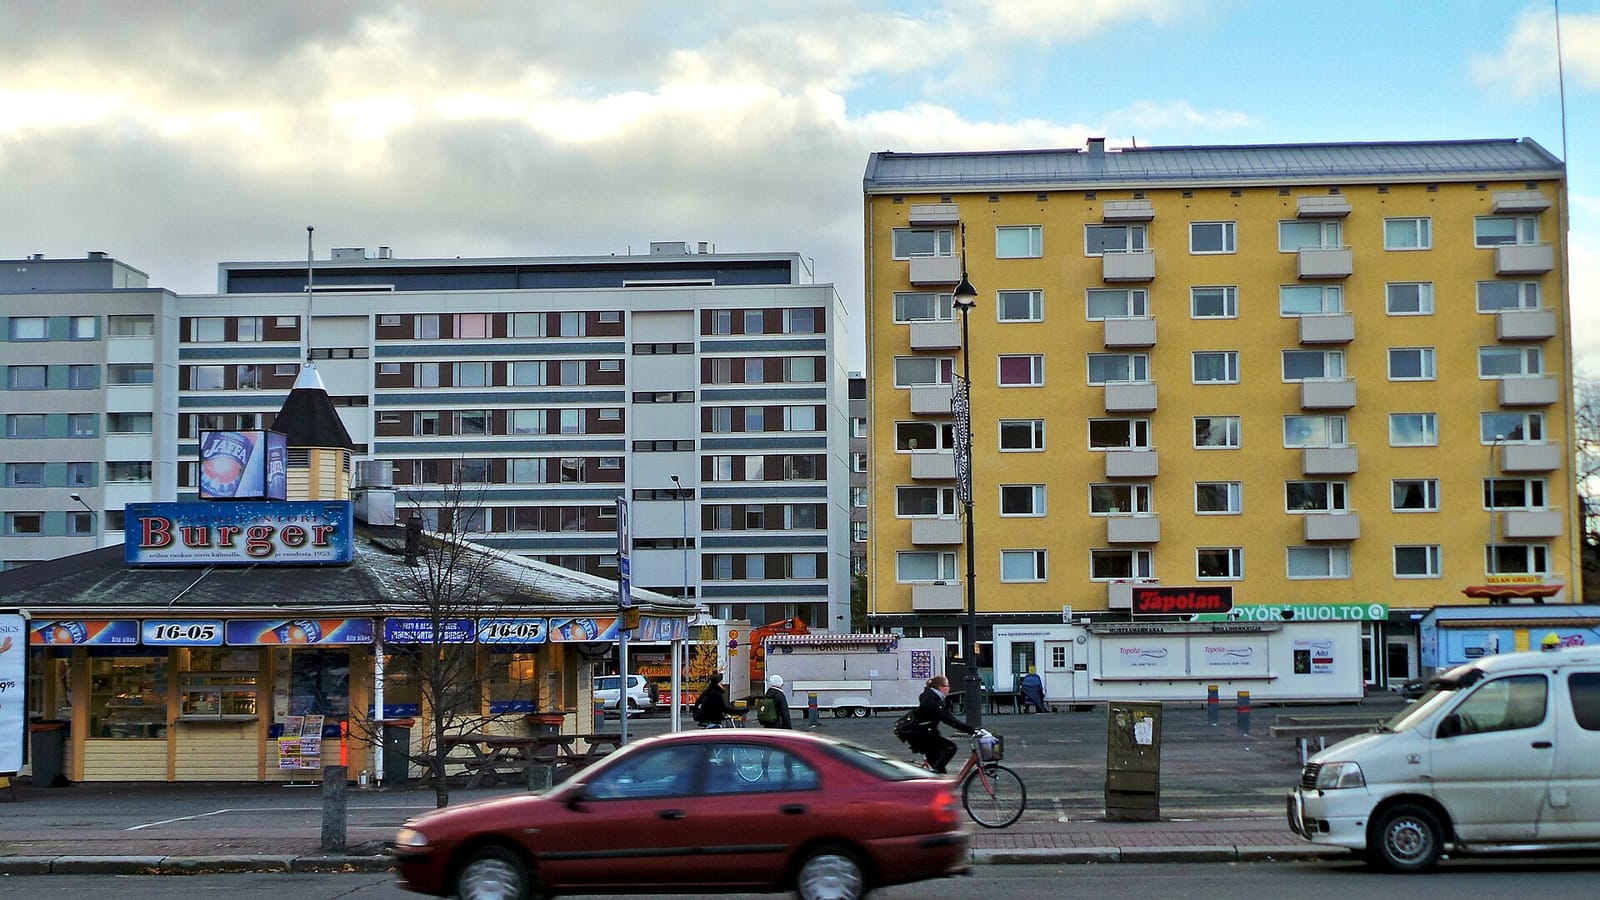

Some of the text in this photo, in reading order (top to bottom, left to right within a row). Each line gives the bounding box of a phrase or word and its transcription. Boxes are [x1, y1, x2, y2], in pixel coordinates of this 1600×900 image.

[138, 516, 337, 556] Burger
[1138, 590, 1222, 612] Tapolan
[153, 624, 216, 640] 16-05
[488, 622, 541, 639] 16-05
